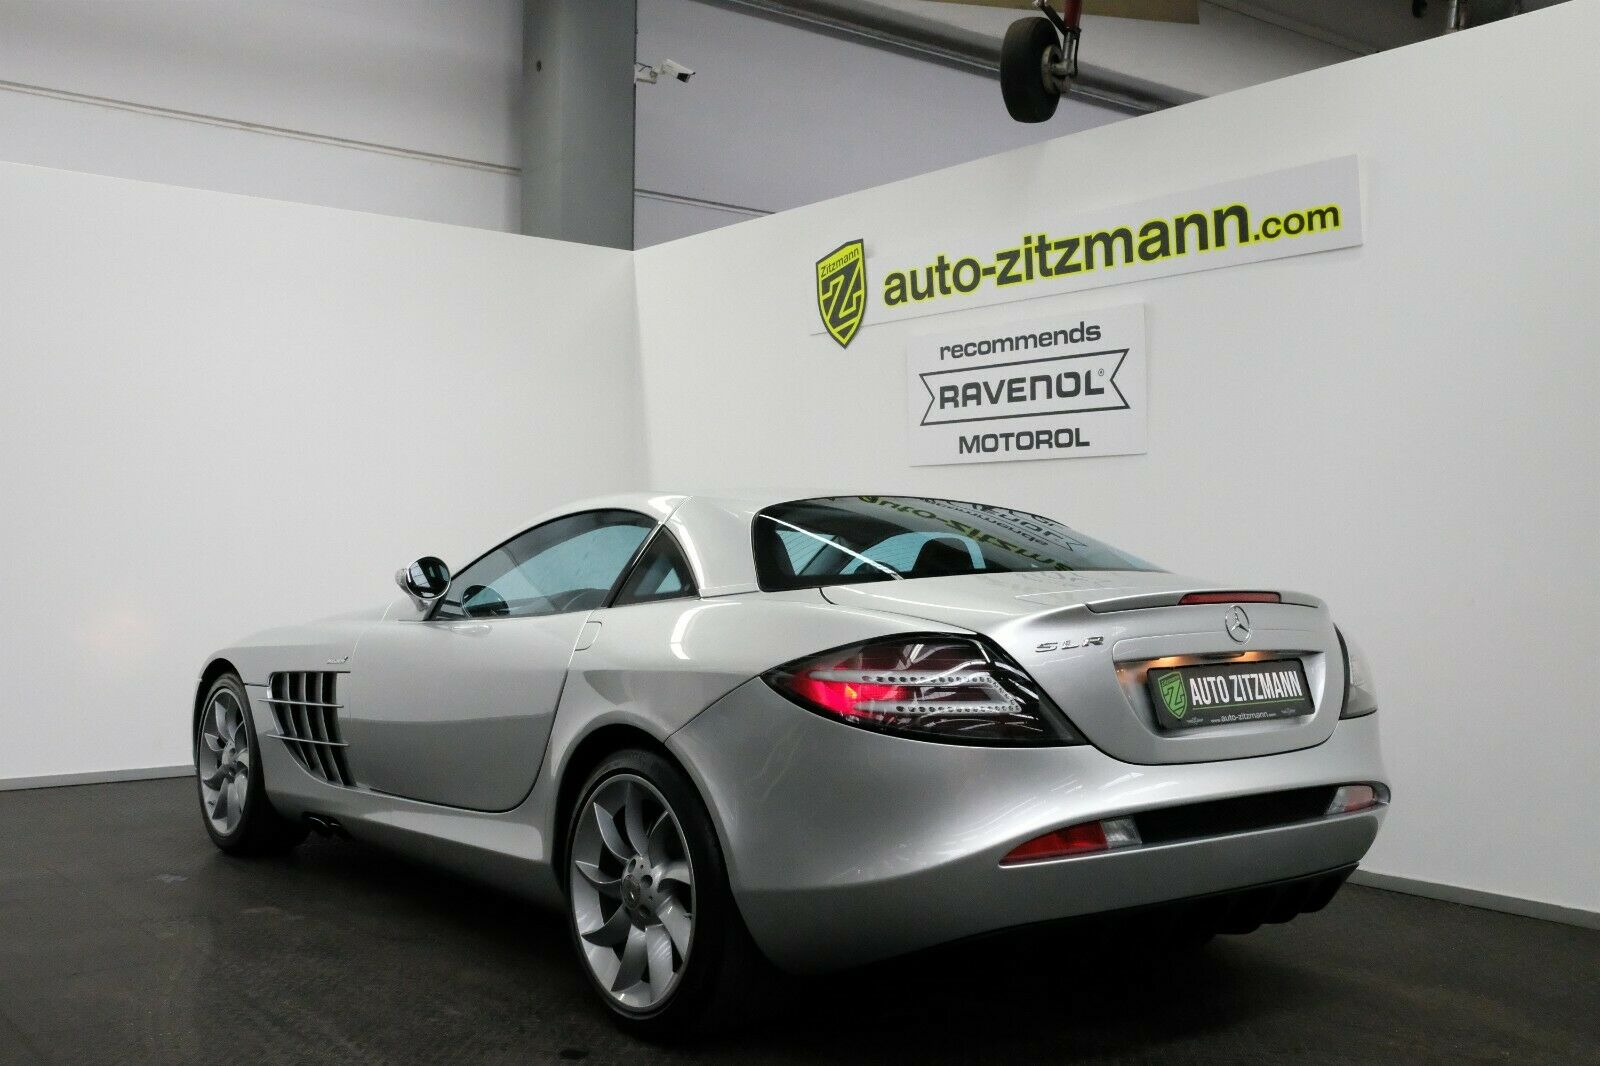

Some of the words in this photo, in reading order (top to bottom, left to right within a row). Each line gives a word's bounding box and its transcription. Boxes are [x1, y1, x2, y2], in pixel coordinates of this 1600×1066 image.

[820, 247, 860, 278] Zitzmann
[884, 203, 1341, 306] auto-zitzmann.com
[940, 321, 1102, 361] recommends
[939, 369, 1105, 410] RAVENOL
[959, 427, 1090, 454] MOTOROL
[1035, 635, 1104, 653] SLR
[1189, 675, 1230, 706] AUTO
[1228, 670, 1303, 702] ZITZMANN
